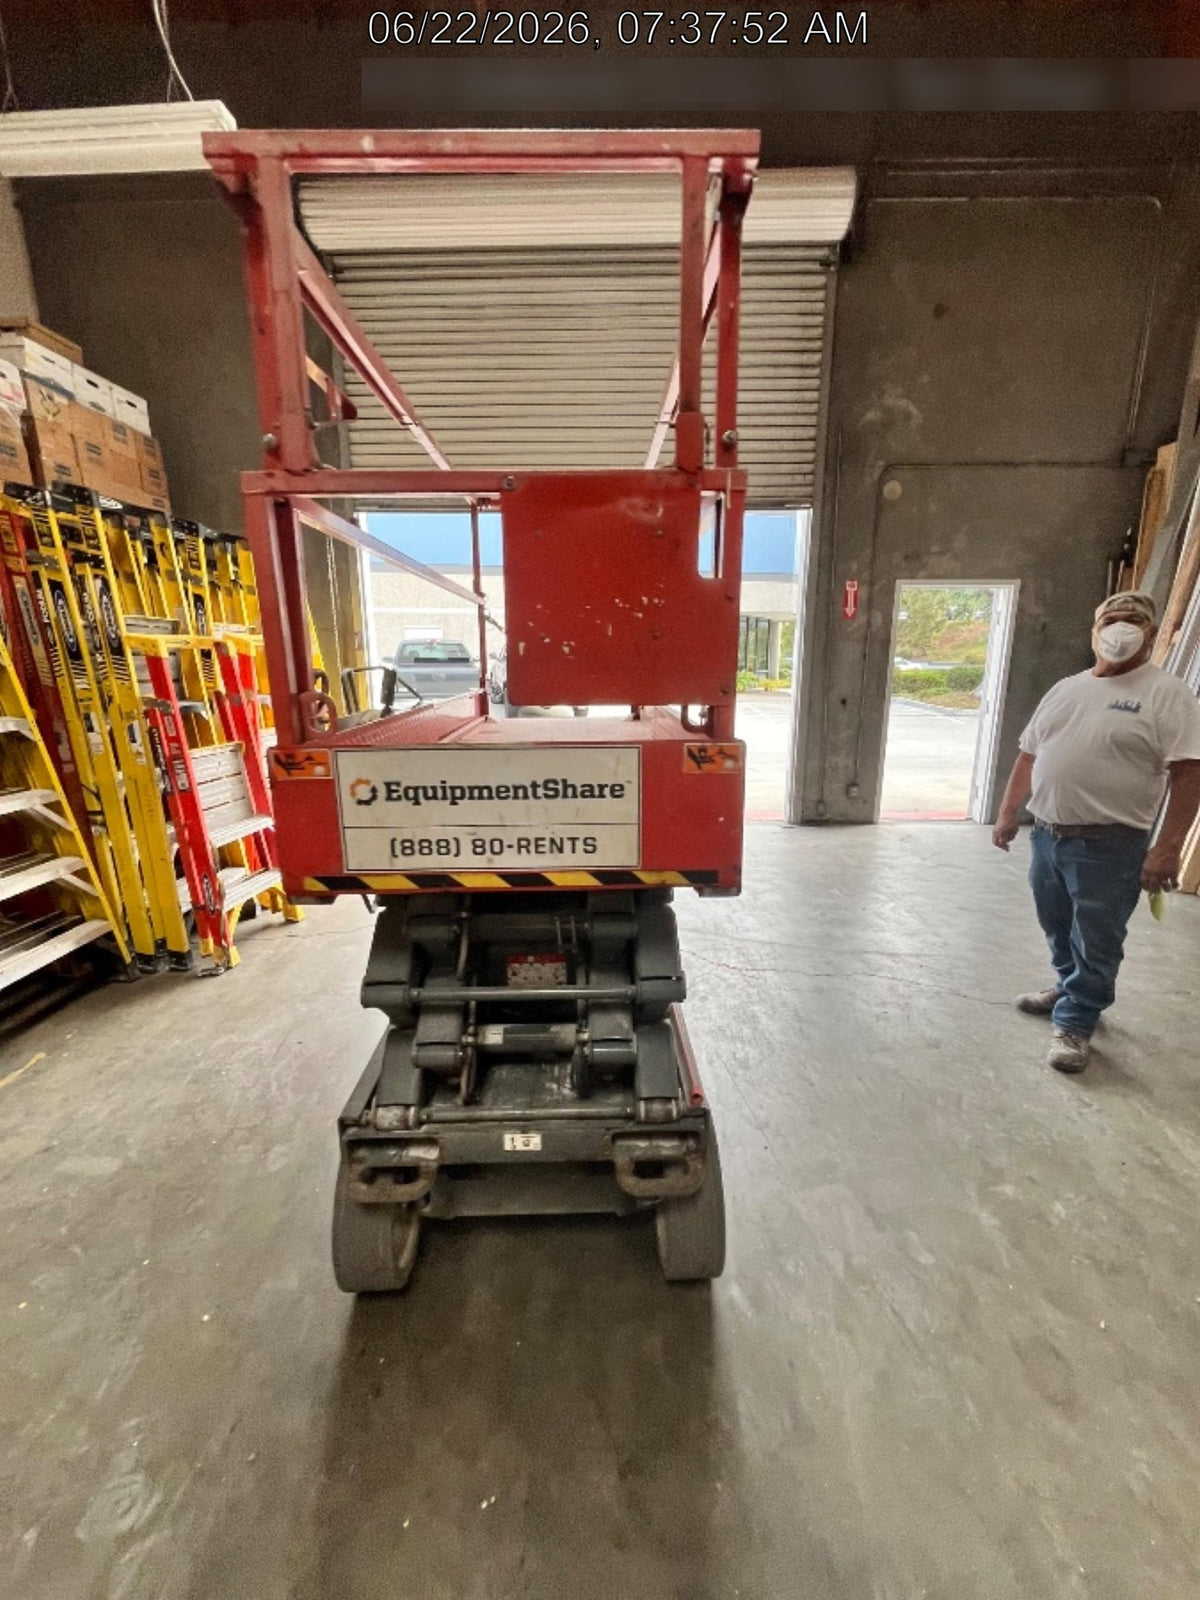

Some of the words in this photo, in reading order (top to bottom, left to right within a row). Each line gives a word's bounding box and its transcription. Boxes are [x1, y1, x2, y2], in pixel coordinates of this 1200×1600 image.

[383, 778, 625, 805] EquipmentShare
[389, 838, 461, 858] (888)
[471, 836, 598, 857] 80-RENTS
